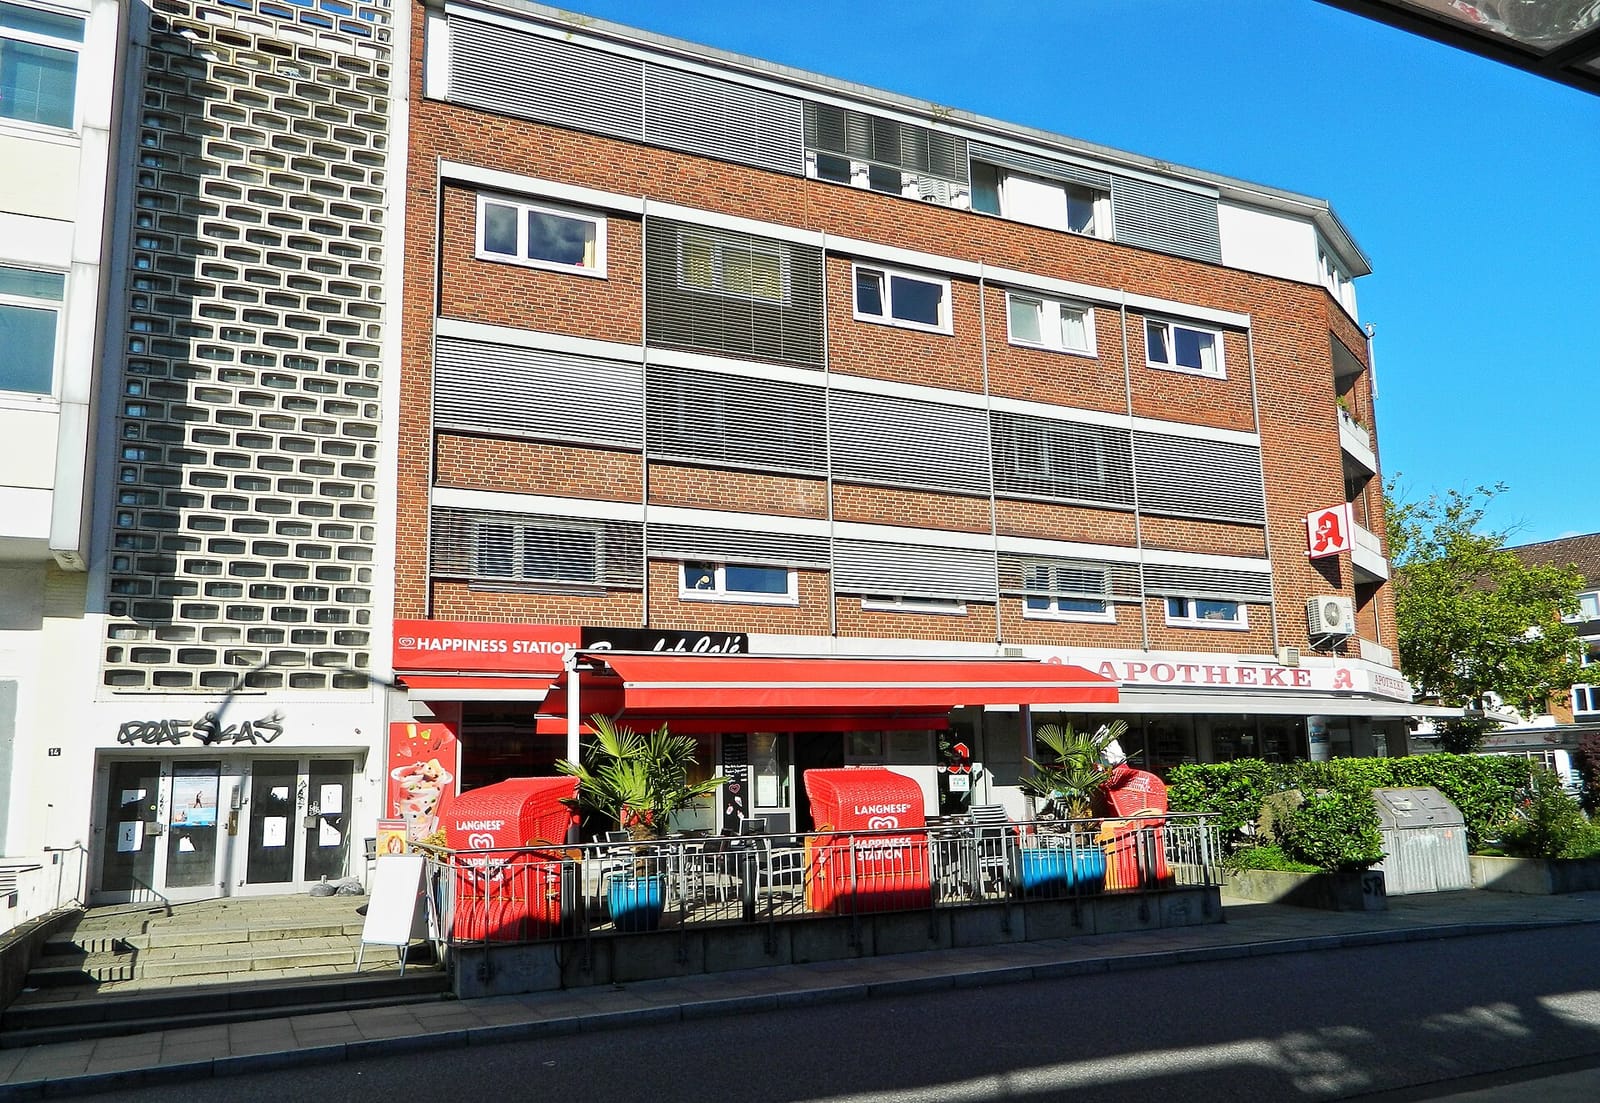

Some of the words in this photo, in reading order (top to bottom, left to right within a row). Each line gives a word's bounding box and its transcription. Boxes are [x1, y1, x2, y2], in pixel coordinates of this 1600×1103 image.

[417, 638, 507, 653] HAPPINESS
[512, 641, 577, 655] STATION
[1098, 661, 1311, 687] APOTHEKE
